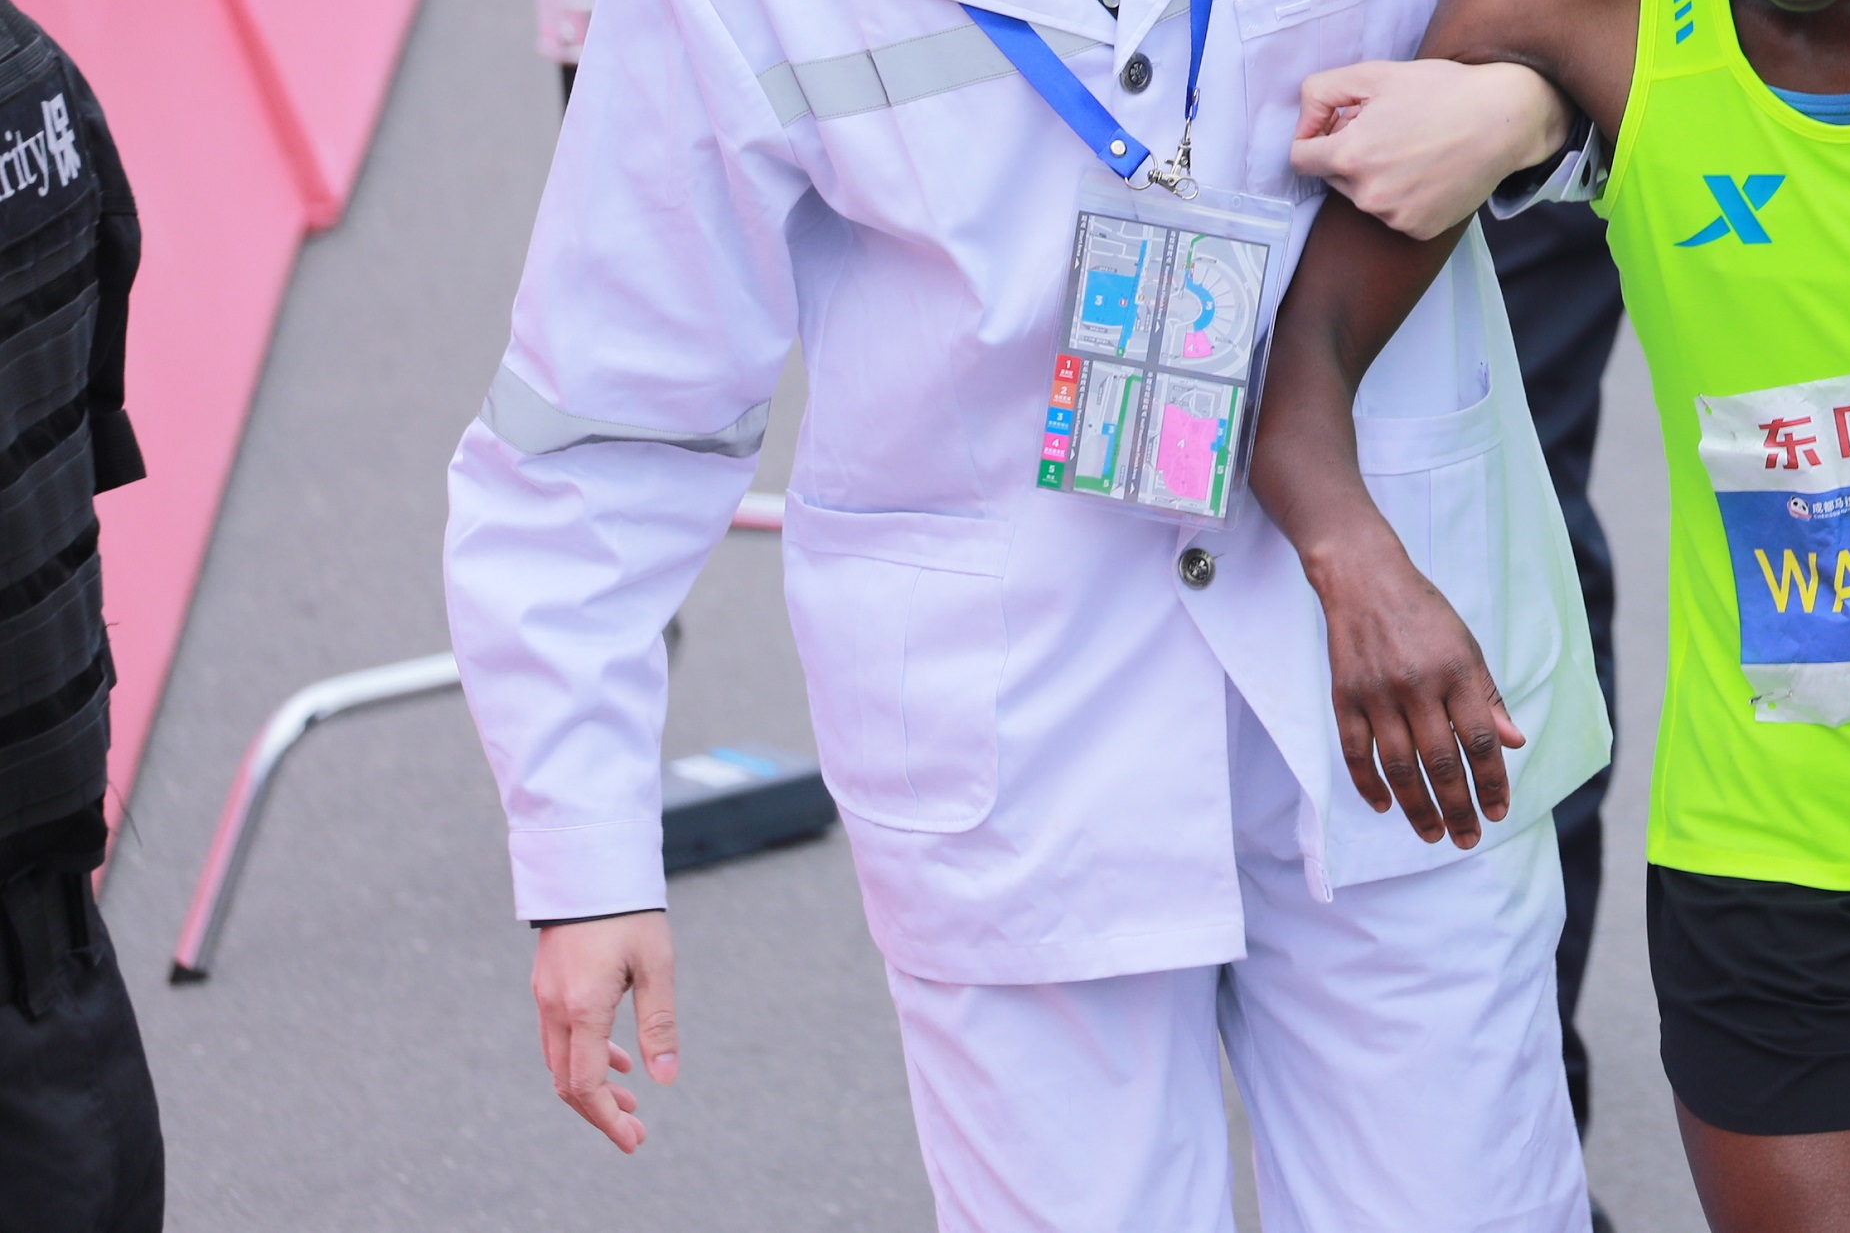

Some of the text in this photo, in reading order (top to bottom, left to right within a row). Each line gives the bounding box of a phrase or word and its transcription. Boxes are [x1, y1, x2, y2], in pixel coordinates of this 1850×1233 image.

[1066, 360, 1072, 369] 1
[1060, 386, 1068, 395] 2
[1056, 413, 1064, 422] 3
[1052, 439, 1060, 448] 4
[1177, 439, 1185, 449] 4
